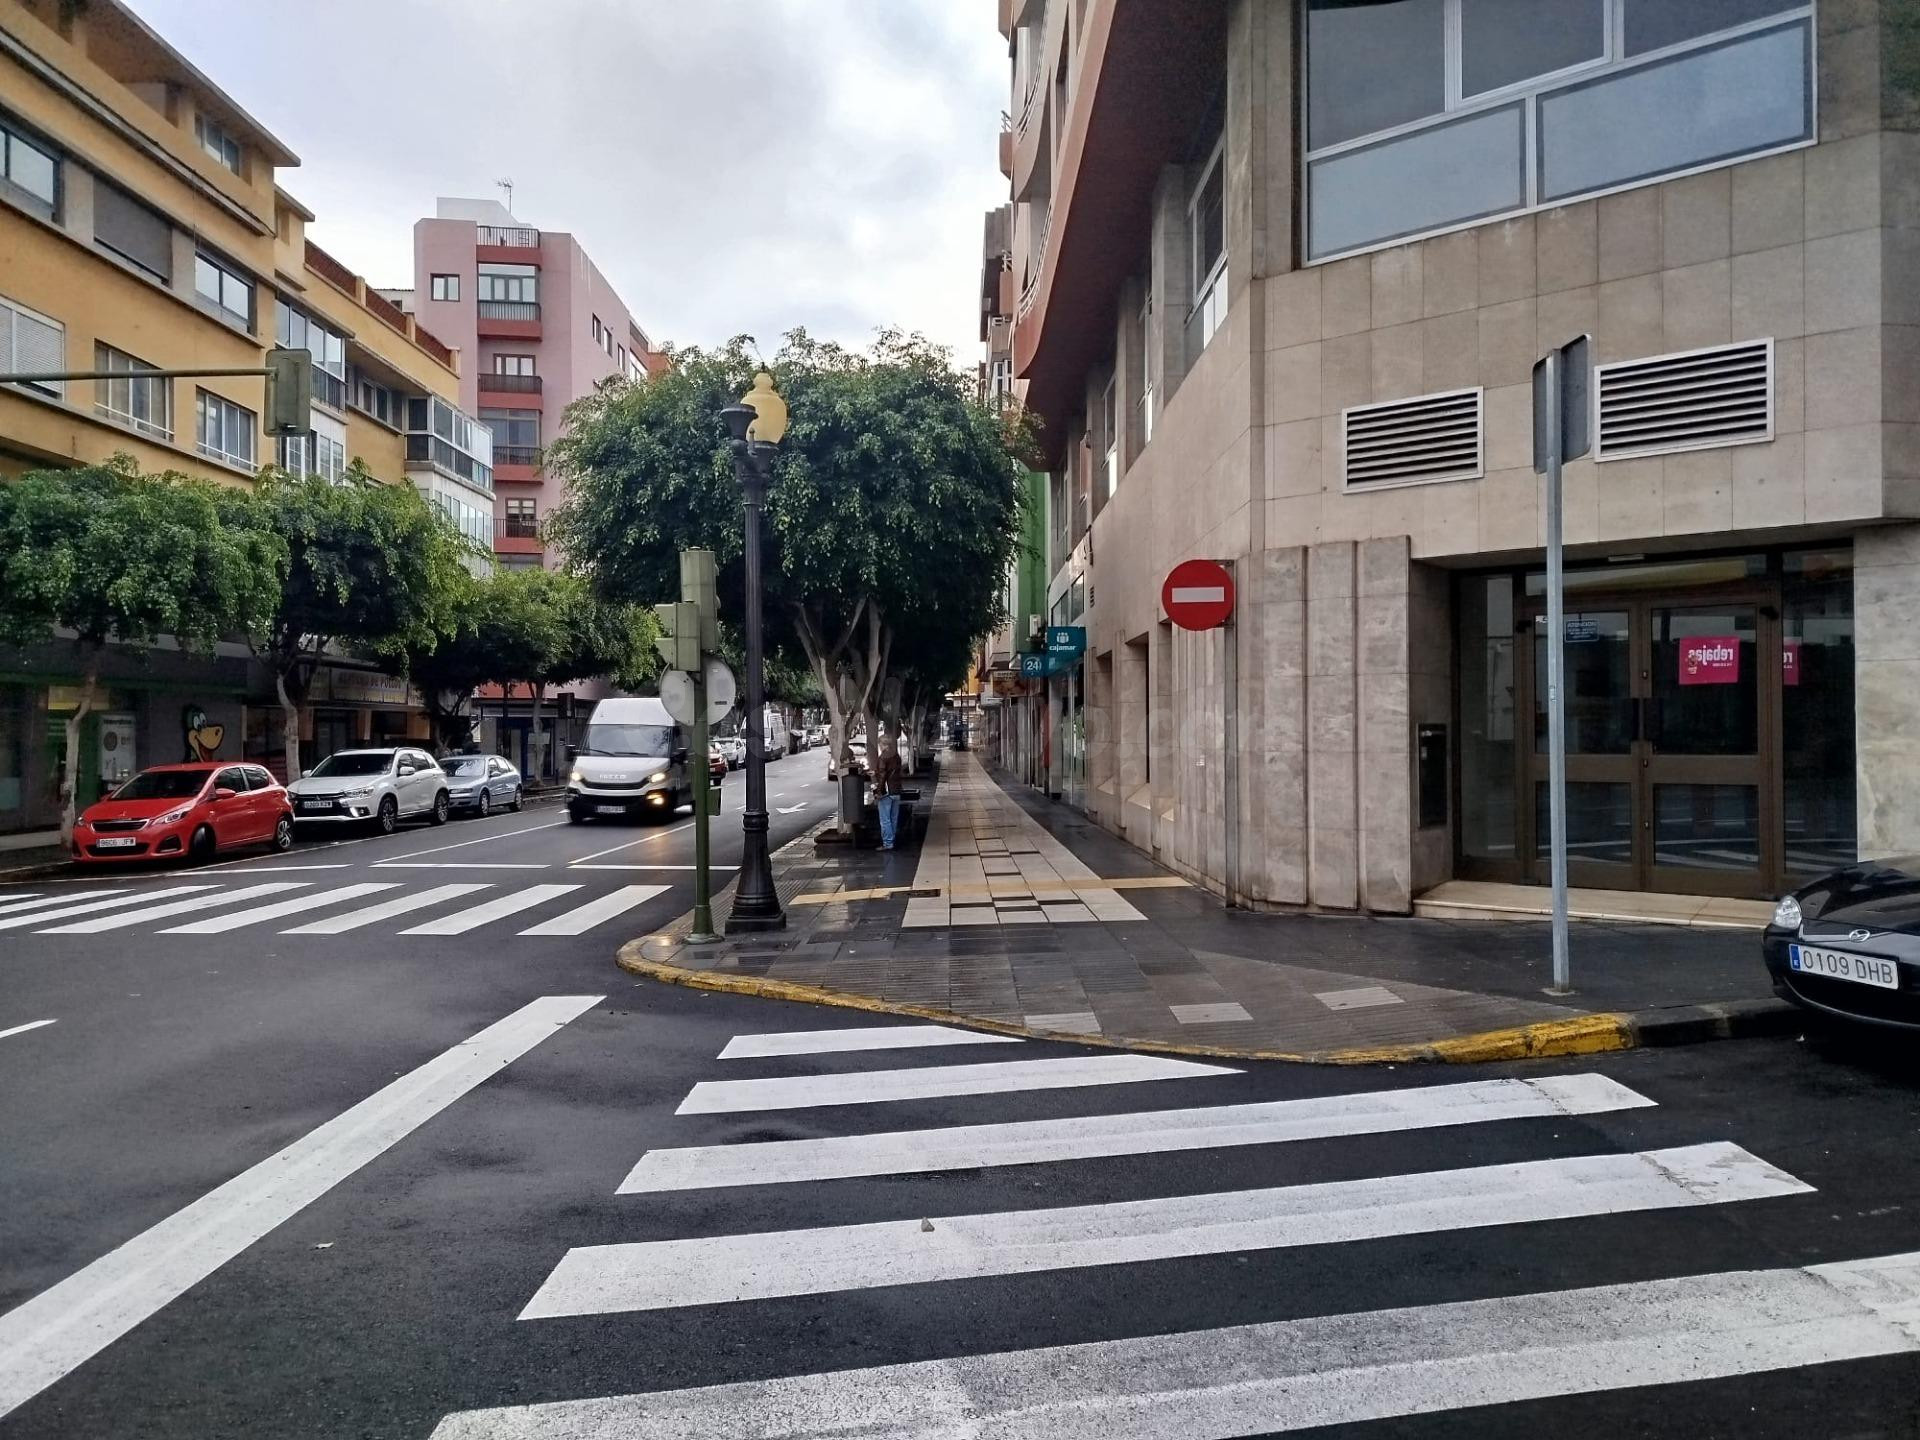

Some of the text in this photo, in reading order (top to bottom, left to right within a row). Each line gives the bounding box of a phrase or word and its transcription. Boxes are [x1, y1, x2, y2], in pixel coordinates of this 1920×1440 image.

[1049, 644, 1076, 652] cajamar
[1803, 950, 1893, 984] 0109 DHB
